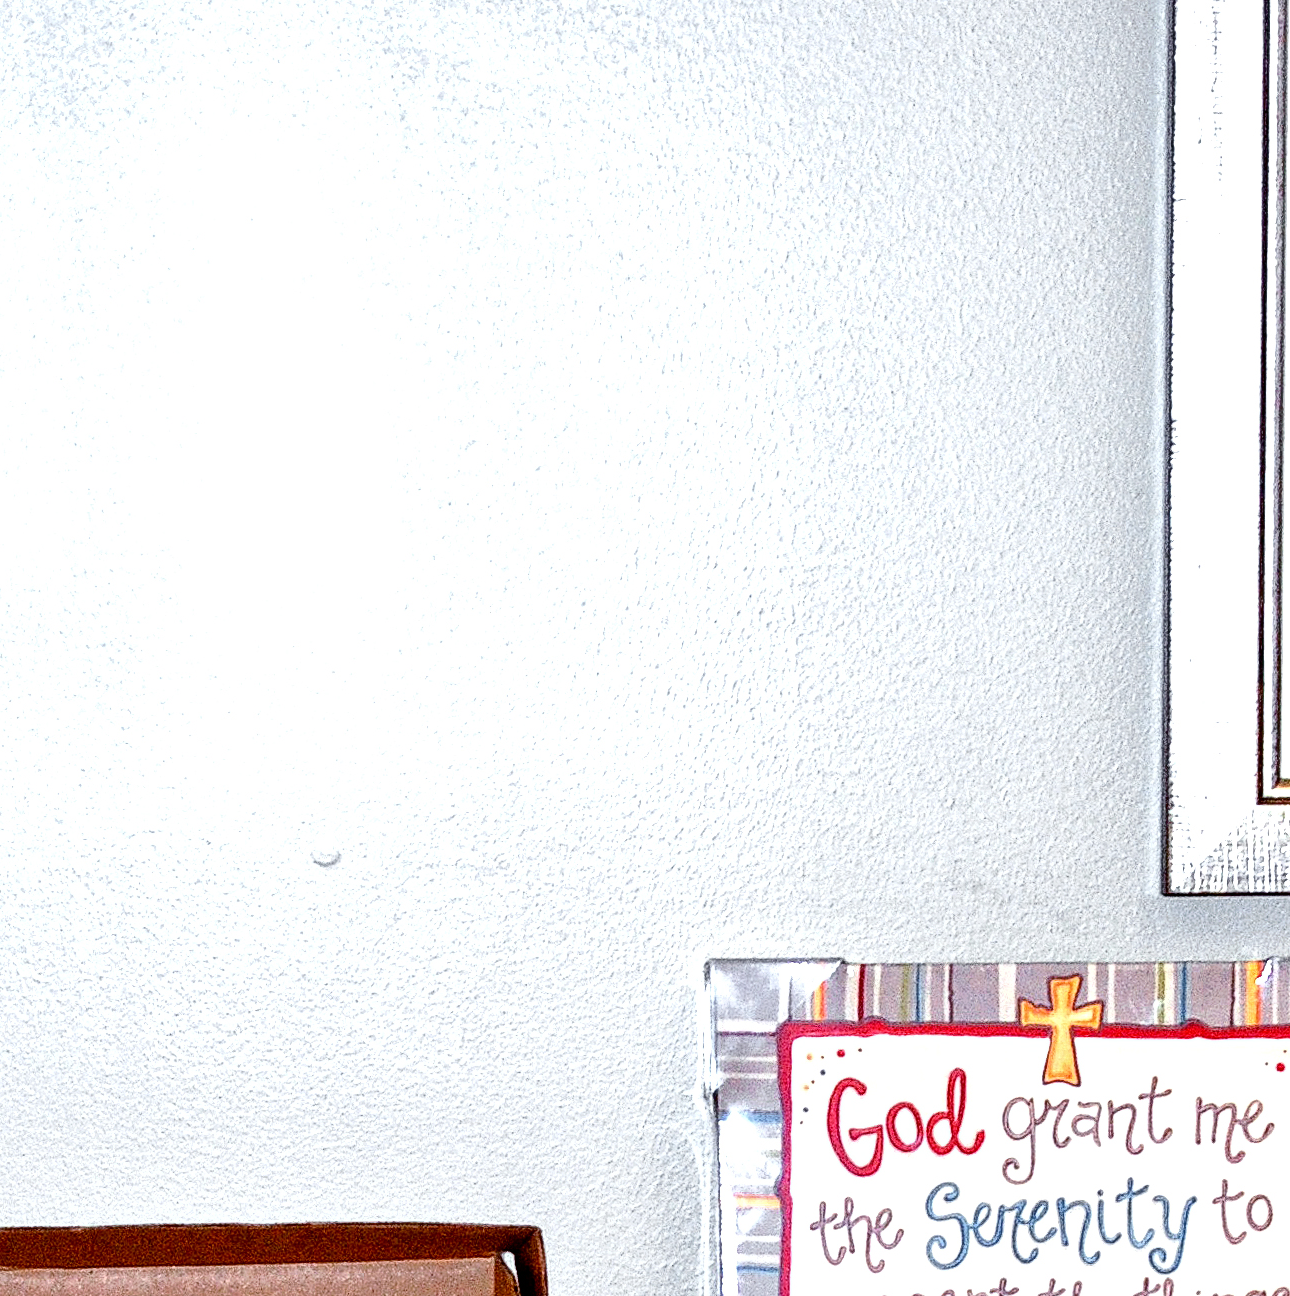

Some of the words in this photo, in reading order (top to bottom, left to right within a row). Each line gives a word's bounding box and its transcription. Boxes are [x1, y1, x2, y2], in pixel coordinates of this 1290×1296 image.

[825, 1067, 985, 1177] God
[1001, 1076, 1173, 1184] grant
[1195, 1093, 1275, 1164] me
[809, 1197, 905, 1275] the
[925, 1176, 1198, 1275] Serenity
[1214, 1180, 1275, 1243] to
